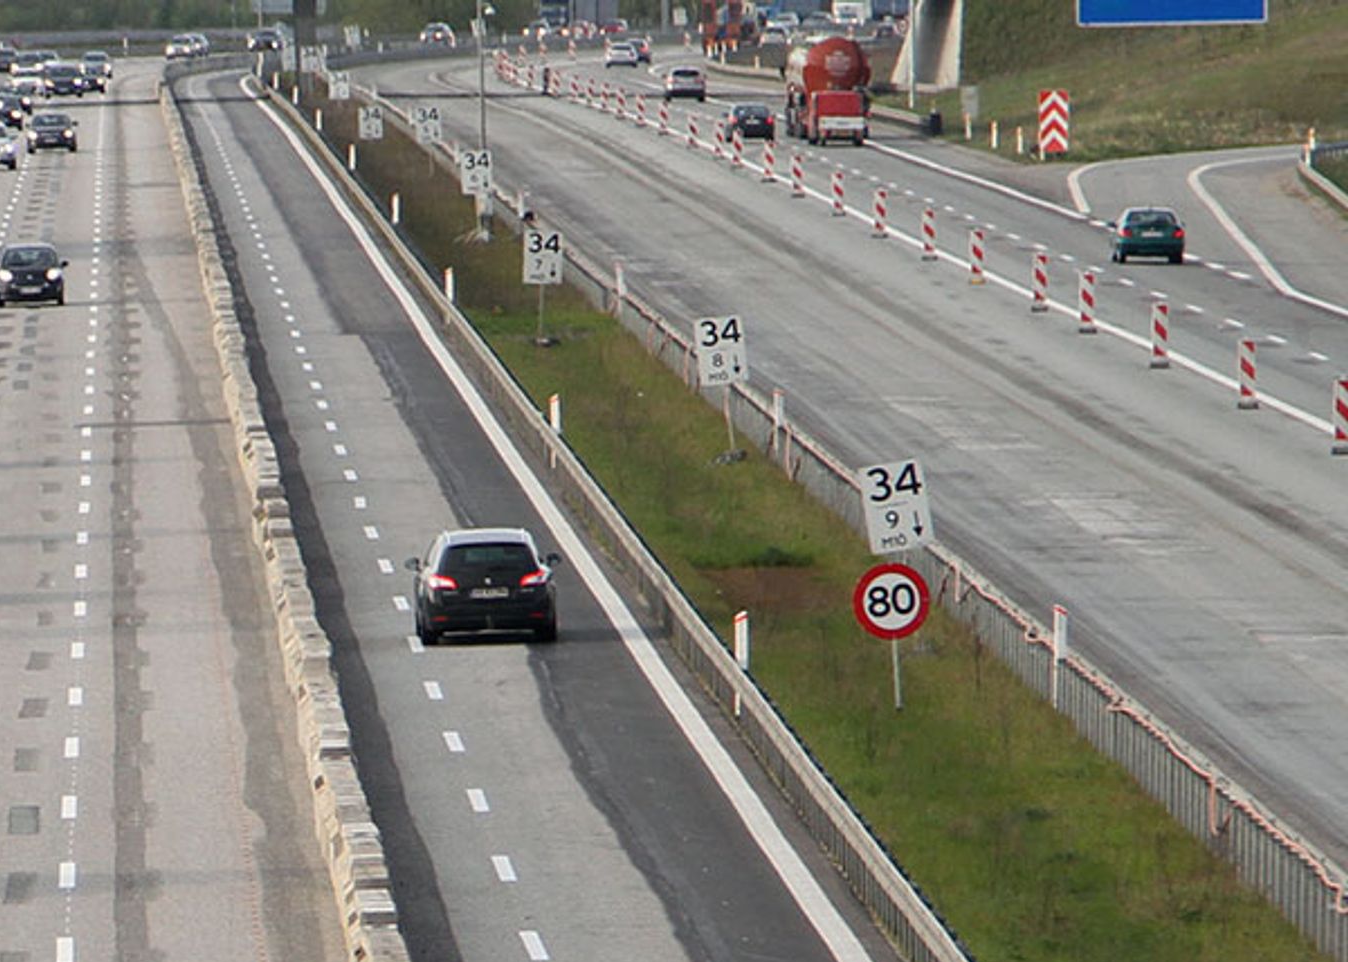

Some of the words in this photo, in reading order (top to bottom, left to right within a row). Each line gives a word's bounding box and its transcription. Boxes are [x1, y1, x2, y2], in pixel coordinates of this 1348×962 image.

[418, 108, 439, 123] 34
[464, 153, 489, 169] 34
[529, 233, 560, 253] 34
[700, 318, 741, 347] 34
[712, 352, 723, 367] 8
[867, 463, 922, 502] 34
[885, 510, 899, 529] 9
[868, 583, 915, 617] 80
